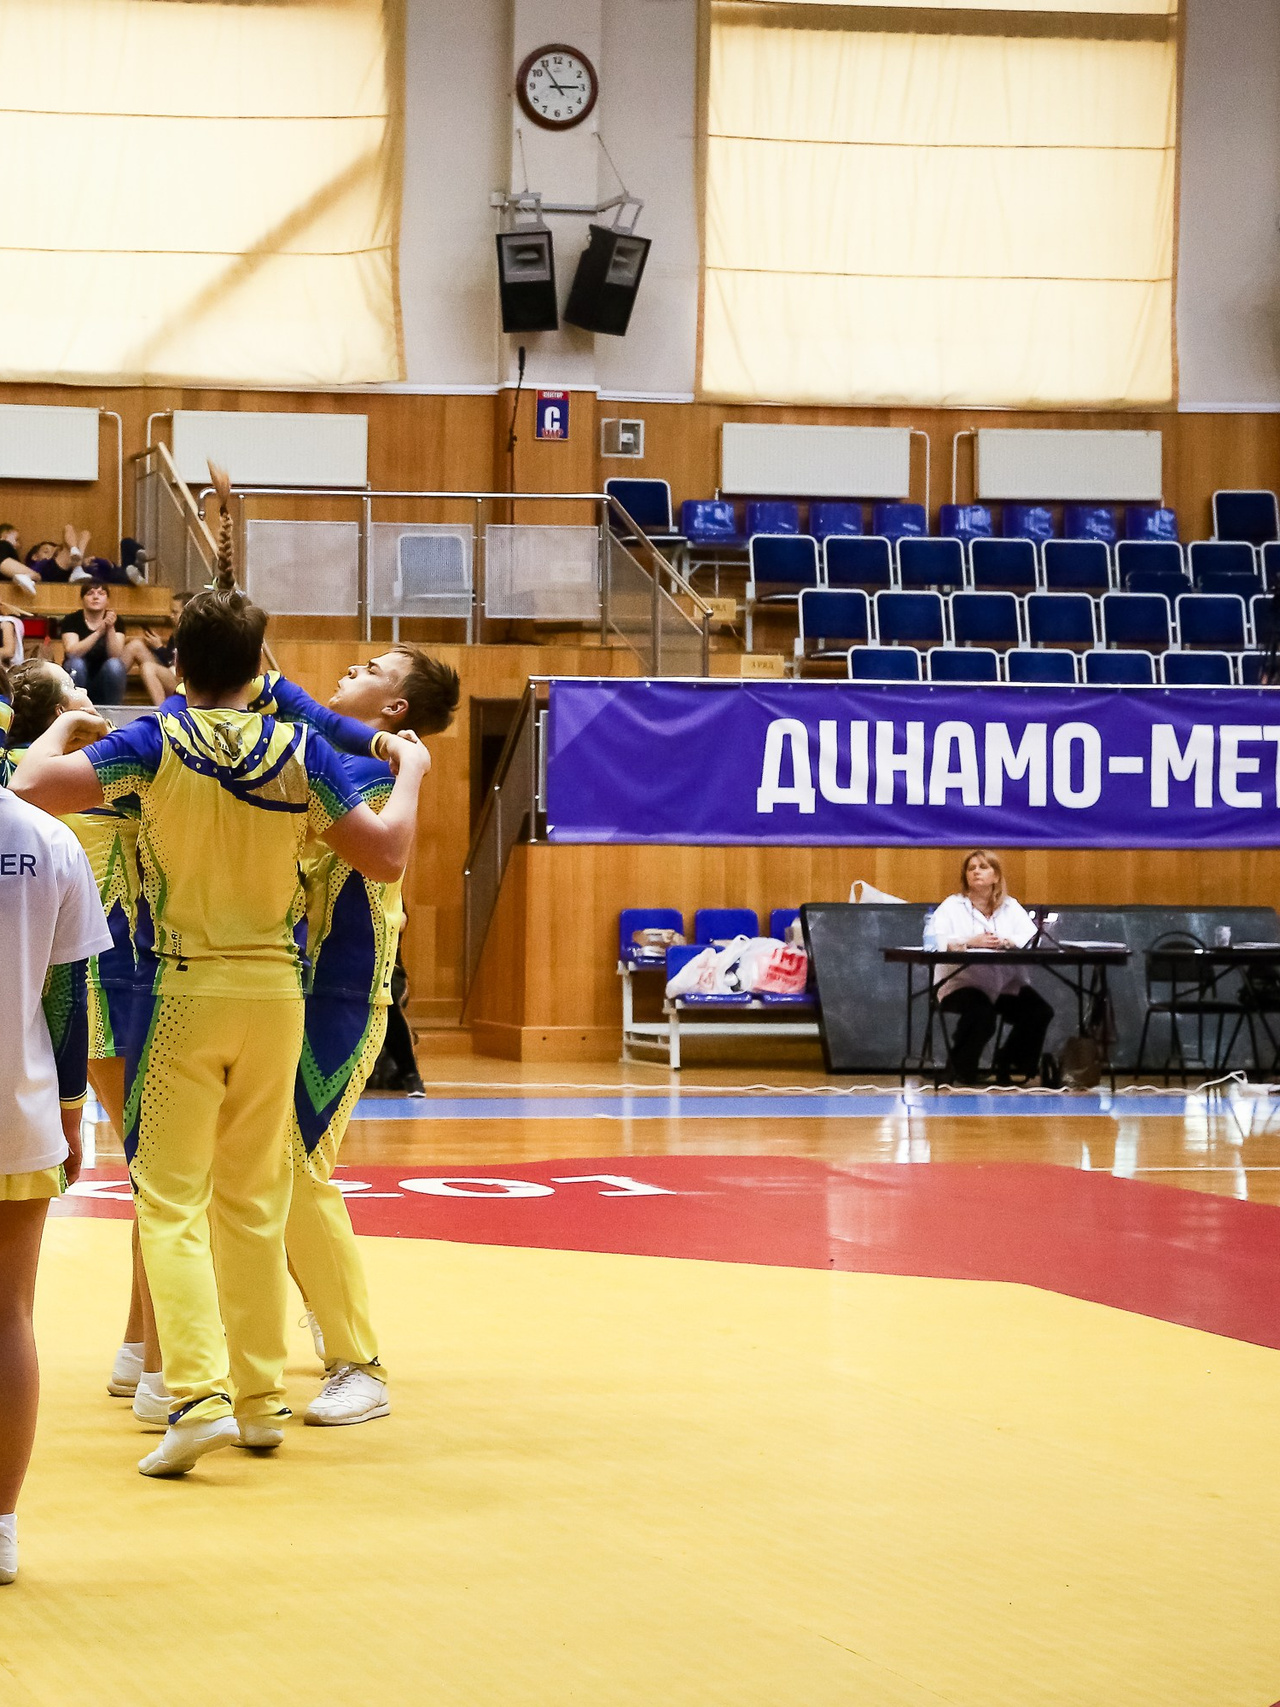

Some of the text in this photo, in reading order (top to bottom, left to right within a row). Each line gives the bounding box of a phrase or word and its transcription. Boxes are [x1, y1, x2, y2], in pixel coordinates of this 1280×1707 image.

[553, 56, 563, 64] 12
[532, 69, 542, 77] 10
[576, 70, 582, 78] 2
[529, 82, 536, 90] 9
[542, 105, 547, 113] 7
[554, 109, 560, 117] 6
[567, 106, 573, 114] 5
